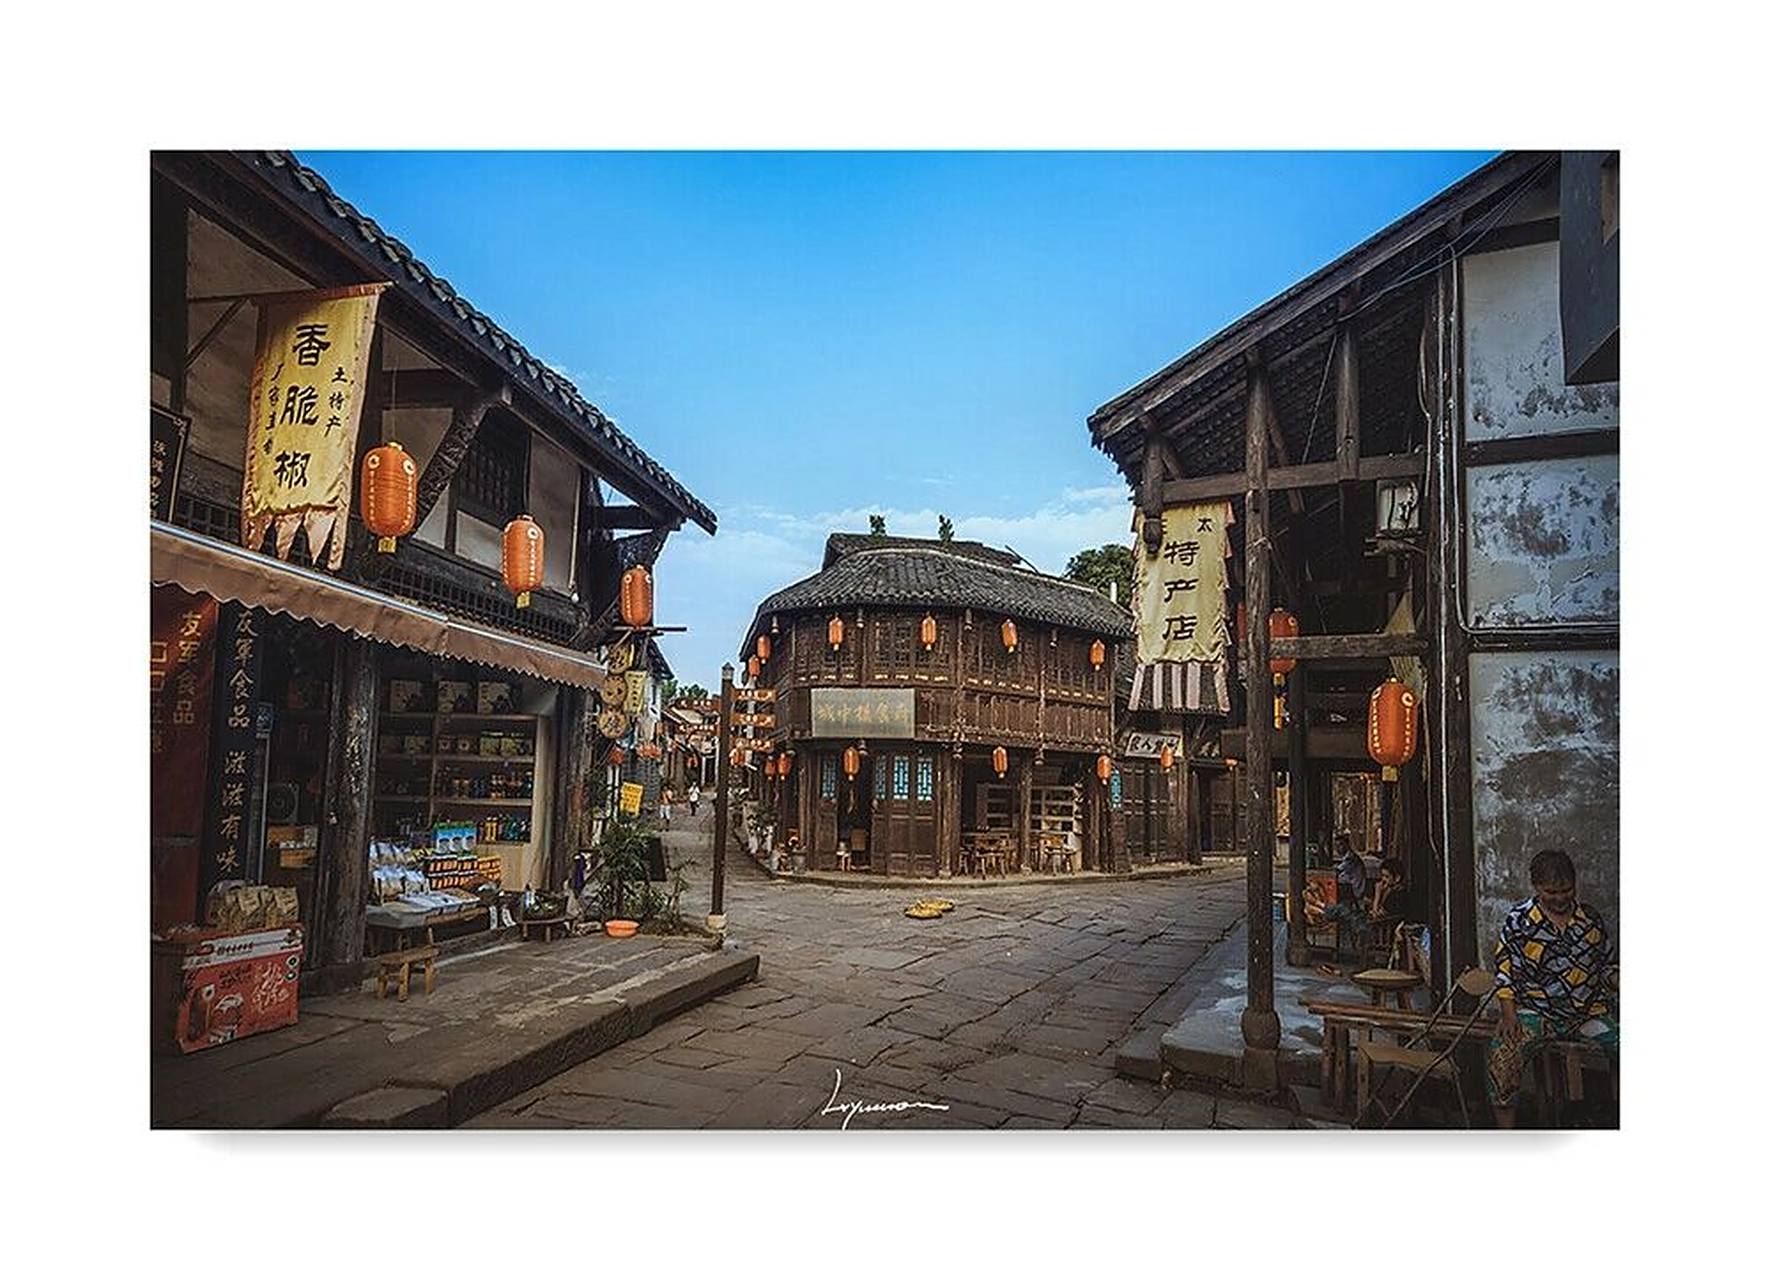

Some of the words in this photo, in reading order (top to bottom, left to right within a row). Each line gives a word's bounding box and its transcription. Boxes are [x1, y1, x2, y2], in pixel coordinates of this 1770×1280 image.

[273, 324, 331, 489] 香脆椒
[323, 366, 349, 438] 土特产
[1161, 541, 1201, 641] 特产店
